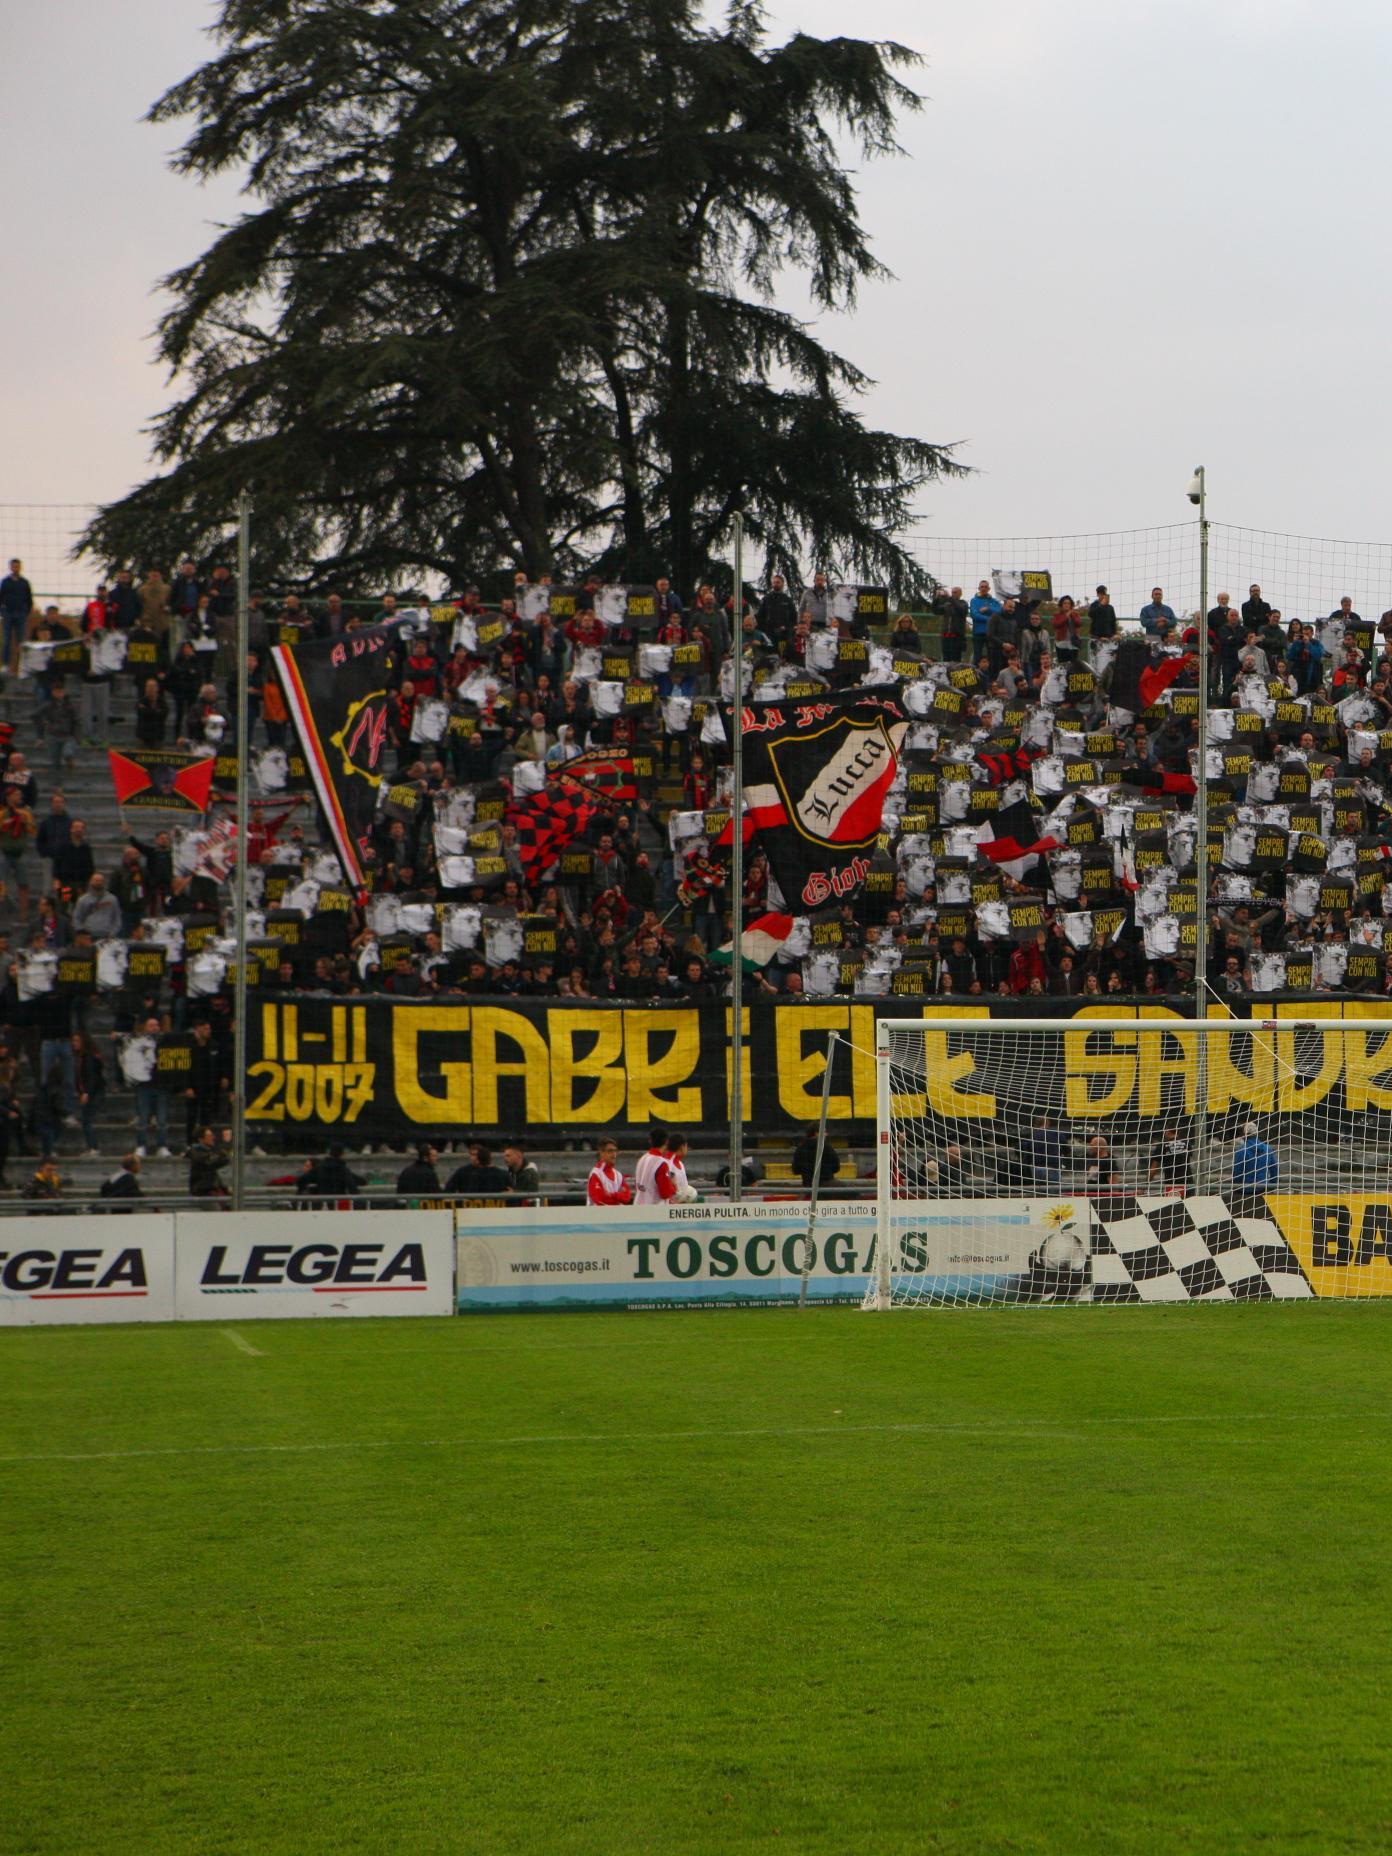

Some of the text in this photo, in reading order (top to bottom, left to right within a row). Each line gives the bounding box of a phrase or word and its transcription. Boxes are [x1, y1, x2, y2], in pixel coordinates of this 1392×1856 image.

[1277, 704, 1302, 713] SEMPRE
[1237, 714, 1260, 722] SEMPRE
[1277, 712, 1302, 722] CON NOI
[1237, 722, 1249, 731] CON
[1226, 755, 1250, 766] SEMPRE
[1067, 764, 1093, 773] SEMPRE
[1227, 765, 1239, 774] CON
[1067, 772, 1094, 781] CON NOI
[1282, 775, 1306, 783] SEMPRE
[804, 738, 886, 825] Lucca
[1282, 783, 1306, 792] CON NOI
[1136, 813, 1161, 821] SEMPRE
[1136, 821, 1162, 830] CON NOI
[1257, 838, 1284, 846] SEMPRE
[1257, 846, 1284, 856] CON NOI
[1084, 870, 1110, 879] SEMPRE
[1084, 878, 1110, 888] CON NOI
[1322, 889, 1348, 898] SEMPRE
[1169, 895, 1196, 903] SEMPRE
[1322, 898, 1347, 907] CON NOI
[1012, 907, 1040, 917] SEMPRE
[1169, 903, 1197, 912] CON NOI
[1012, 916, 1040, 926] CON NOI
[1349, 957, 1376, 966] SEMPRE
[1348, 966, 1376, 976] CON NOI
[894, 974, 923, 983] SEMPRE
[893, 983, 923, 994] CON NOI
[244, 1061, 375, 1123] 2007
[669, 1207, 711, 1219] ENERGIA
[754, 1207, 767, 1217] Un
[769, 1206, 800, 1217] mondo
[821, 1205, 838, 1218] gira
[840, 1207, 846, 1216] a
[848, 1205, 869, 1216] tutto
[627, 1231, 930, 1281] TOSCOGAS
[200, 1243, 428, 1285] LEGEA
[510, 1257, 611, 1276] www.toscogas.it
[0, 1247, 148, 1291] GEA
